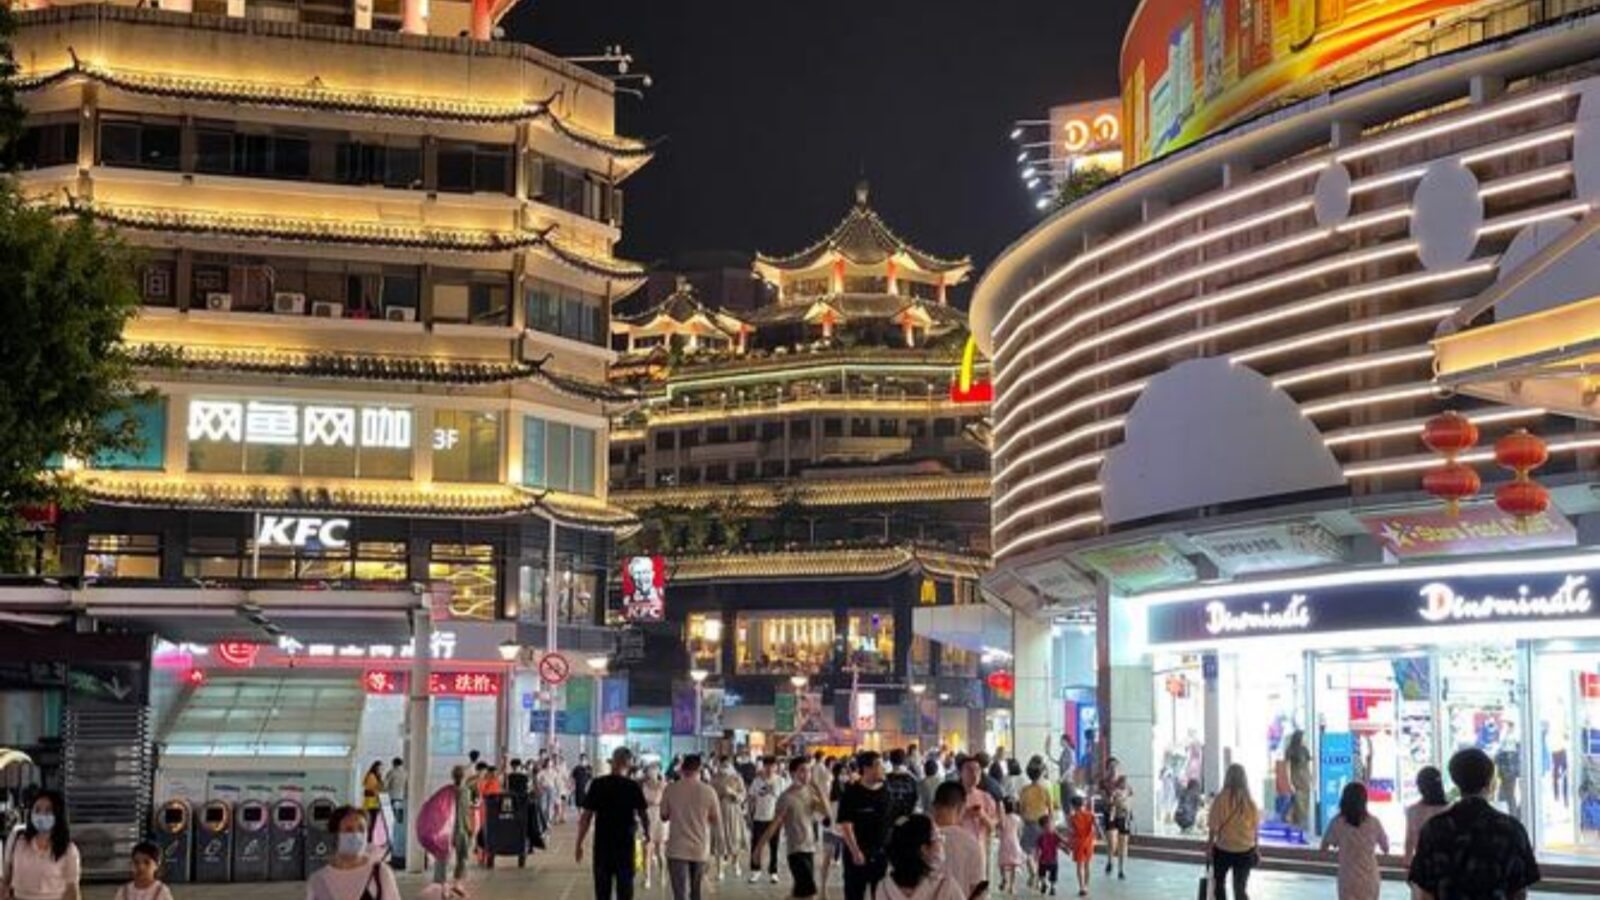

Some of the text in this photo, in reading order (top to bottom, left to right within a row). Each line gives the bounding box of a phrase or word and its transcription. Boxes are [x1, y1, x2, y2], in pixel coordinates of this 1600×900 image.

[188, 400, 411, 448] 网鱼网咖
[432, 428, 459, 450] 3F
[257, 515, 351, 546] KFC
[627, 605, 661, 619] KFC
